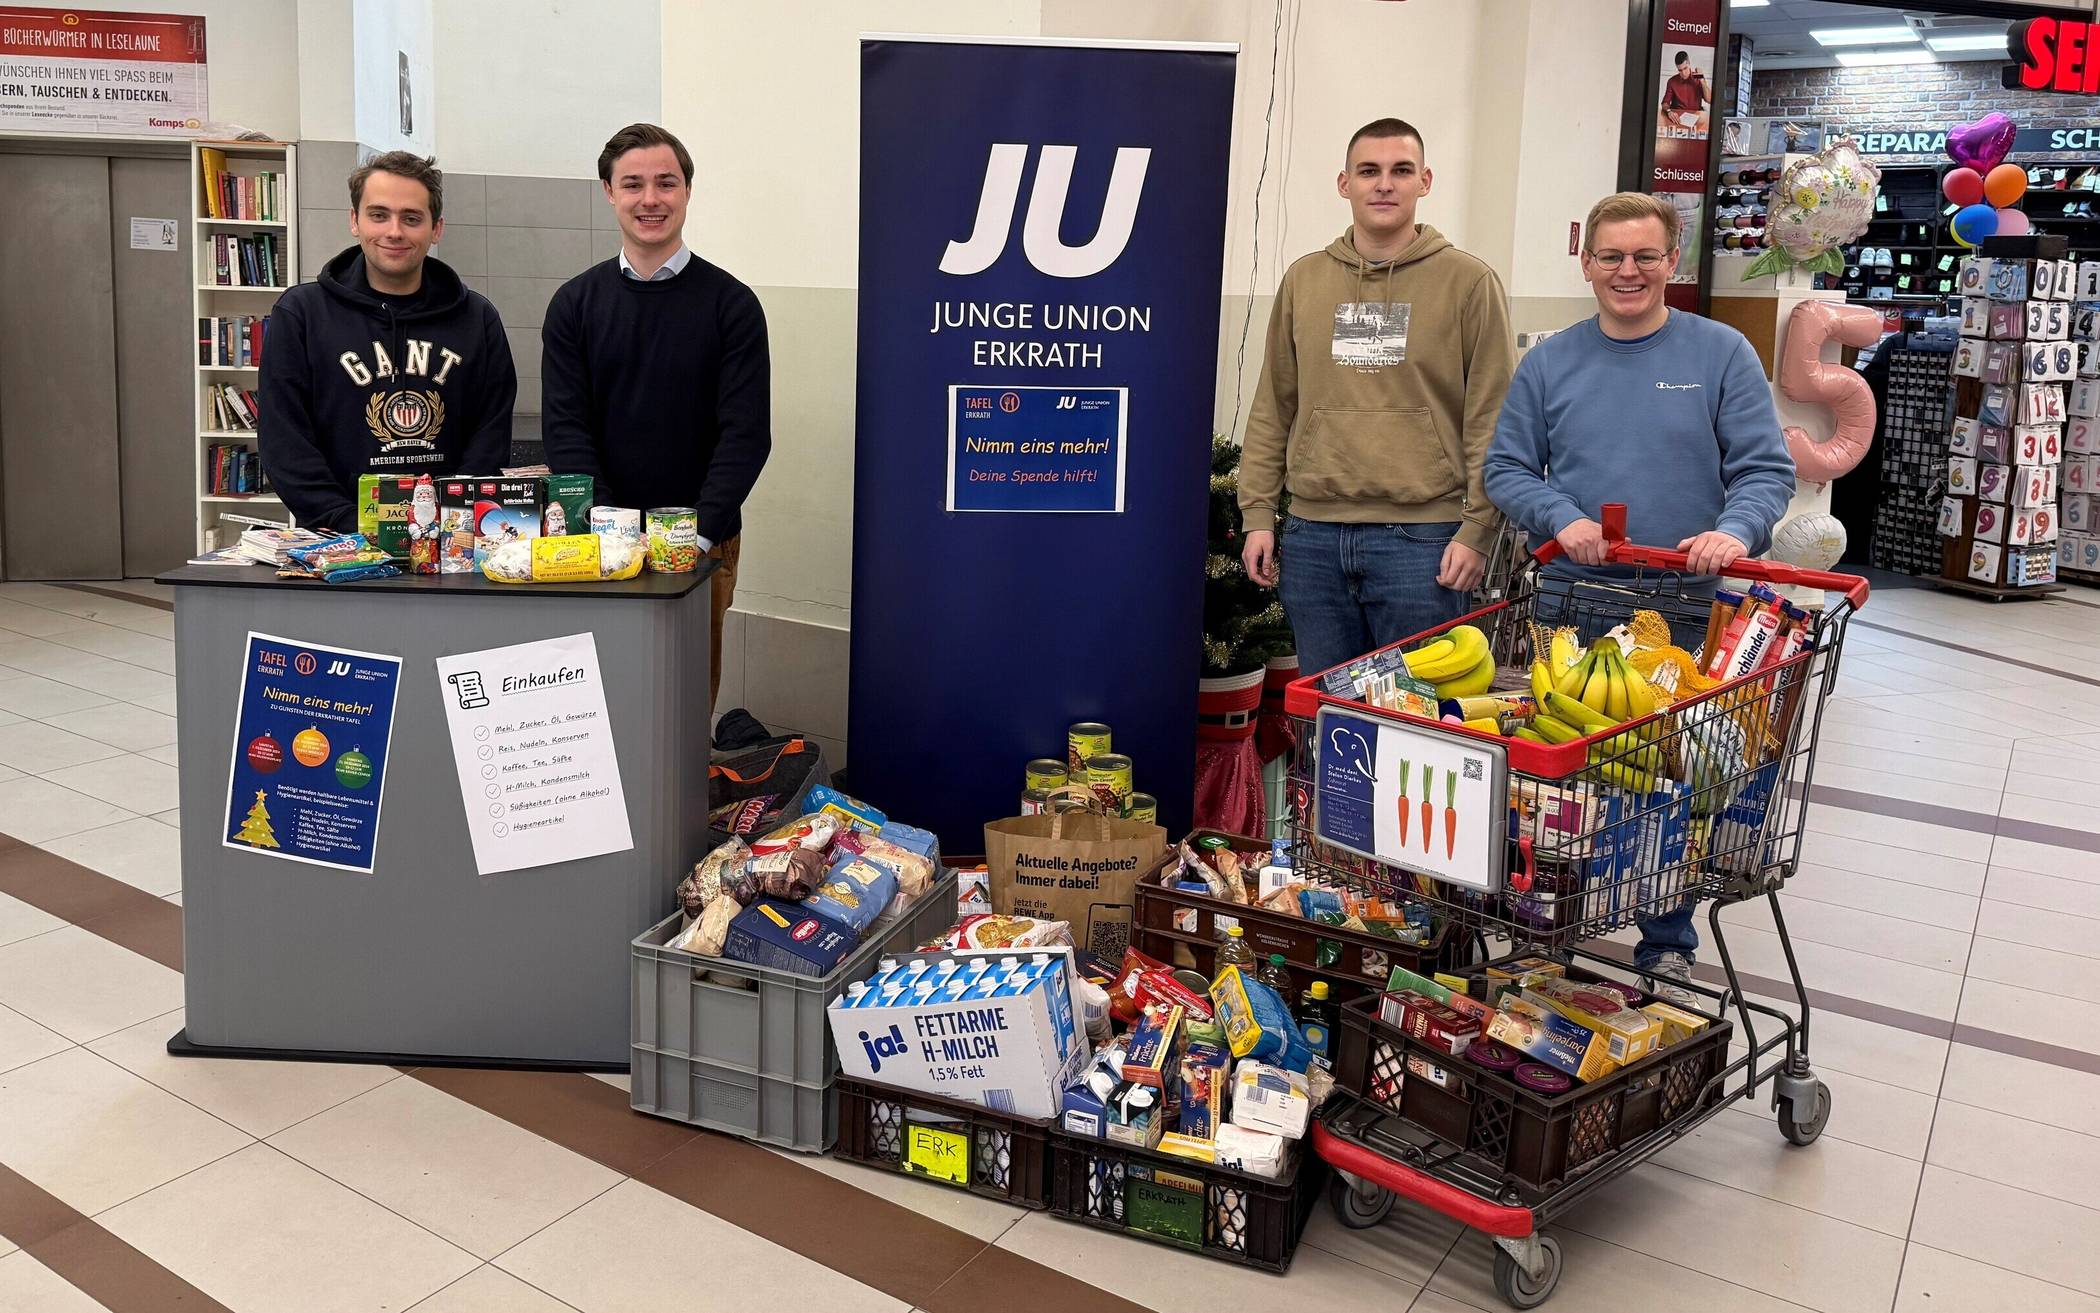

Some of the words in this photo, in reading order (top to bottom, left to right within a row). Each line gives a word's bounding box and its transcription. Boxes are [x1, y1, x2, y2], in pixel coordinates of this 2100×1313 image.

[1668, 19, 1712, 34] Stempel
[91, 33, 103, 48] IN
[106, 33, 161, 52] LESELAUNE
[55, 67, 87, 82] IHNEN
[90, 68, 112, 82] VIEL
[114, 69, 146, 83] SPASS
[149, 70, 174, 84] BEIM
[0, 84, 28, 98] ERN,
[31, 85, 88, 99] TAUSCHEN
[92, 89, 101, 100] &
[105, 89, 173, 103] ENTDECKEN.
[149, 118, 185, 129] Kamps
[1851, 132, 1947, 153] REPARA
[1654, 168, 1704, 181] Schlüssel
[938, 142, 1152, 278] JU
[2035, 266, 2049, 291] 0
[931, 301, 1033, 333] JUNGE
[1043, 304, 1152, 333] UNION
[2029, 306, 2043, 333] 3
[2048, 307, 2062, 335] 5
[2078, 312, 2094, 335] 4
[339, 338, 463, 387] GANT
[973, 340, 1103, 368] ERKRATH
[2032, 349, 2048, 376] 6
[2056, 348, 2072, 374] 8
[1656, 382, 1702, 391] Champion
[965, 397, 993, 409] TAFEL
[1056, 396, 1077, 410] JU
[2032, 394, 2042, 417] 1
[965, 411, 991, 419] ERKRATH
[965, 436, 1014, 454] Nimm
[1020, 438, 1055, 454] eins
[1060, 437, 1110, 455] mehr!
[1953, 426, 1968, 448] 5
[2024, 435, 2036, 459] 3
[2045, 434, 2057, 458] 4
[2073, 425, 2088, 448] 2
[370, 456, 405, 466] AMERICAN
[511, 483, 523, 491] drei
[969, 469, 1006, 482] Deine
[1011, 469, 1060, 485] Spende
[1063, 469, 1098, 483] hilft!
[1950, 467, 1964, 487] 6
[2069, 465, 2083, 489] 4
[1977, 508, 1995, 534] 9
[2034, 511, 2050, 540] 9
[1972, 551, 1986, 572] 9
[1759, 614, 1777, 629] Meica
[259, 650, 287, 667] TAFEL
[1738, 627, 1768, 678] schländer
[257, 665, 284, 677] ERKRATH
[327, 660, 351, 676] JU
[502, 666, 584, 692] Einkaufen
[263, 686, 300, 704] Nimm
[303, 696, 330, 708] eins
[333, 702, 374, 716] mehr!
[279, 705, 303, 715] GUNSTEN
[304, 709, 314, 717] DER
[345, 717, 361, 725] TAFEL
[494, 724, 516, 734] Mehl,
[519, 719, 548, 731] Zucker,
[551, 715, 562, 725] Öl,
[565, 711, 597, 722] Gewürze
[498, 744, 516, 755] Reis,
[519, 738, 549, 751] Nudeln,
[551, 732, 590, 746] Konserven
[502, 762, 528, 773] Kaffee,
[533, 758, 548, 768] Tee,
[551, 753, 573, 765] Säfte
[505, 780, 537, 793] H-Milch,
[540, 771, 591, 787] Kondensmilch
[510, 799, 552, 813] Süßigkeiten
[554, 794, 577, 805] (ohne
[579, 787, 611, 799] Alkohol)
[512, 814, 566, 832] Hygieneartikel
[1015, 853, 1069, 871] Aktuelle
[1071, 856, 1138, 875] Angebote?
[1015, 871, 1056, 887] Immer
[1059, 875, 1099, 890] dabei!
[1013, 897, 1033, 909] Jetzt
[1034, 900, 1048, 909] die
[1013, 907, 1037, 918] REWE
[1038, 910, 1055, 921] App
[795, 920, 817, 939] Barilla
[914, 1007, 1009, 1038] FETTARME
[1493, 1024, 1505, 1037] 25
[858, 1025, 908, 1073] ja!
[920, 1035, 1000, 1062] H-MILCH
[1139, 1038, 1155, 1063] Früchte-
[1542, 1026, 1586, 1055] Darjeeling
[1549, 1047, 1576, 1064] meßmer
[960, 1065, 985, 1079] Fett
[916, 1133, 958, 1157] ERK
[1138, 1188, 1187, 1206] ERKRATH
